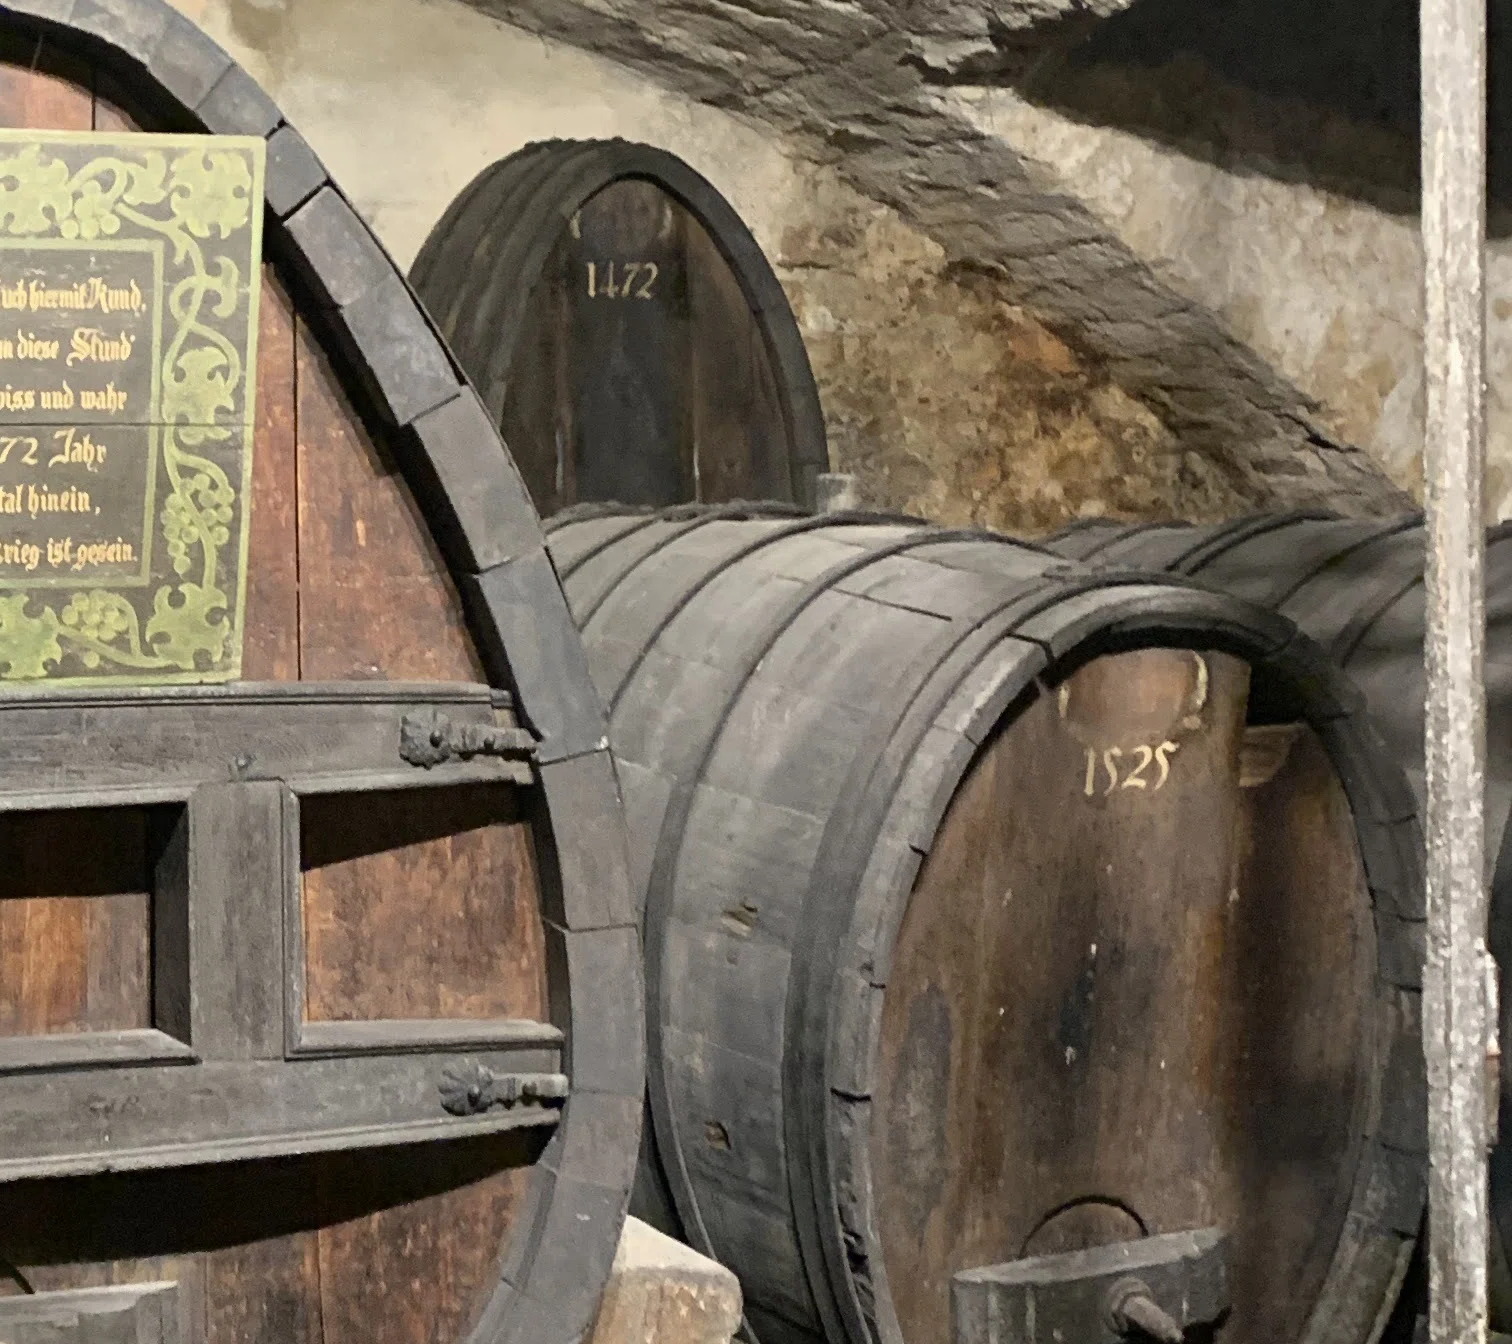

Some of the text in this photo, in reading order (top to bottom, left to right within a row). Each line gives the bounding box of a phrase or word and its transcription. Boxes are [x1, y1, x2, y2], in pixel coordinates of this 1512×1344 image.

[29, 279, 86, 312] hiermit
[584, 260, 659, 300] 1472
[17, 328, 60, 361] diese
[40, 379, 74, 410] und
[80, 381, 128, 415] wahr
[48, 427, 107, 473] Jahr
[28, 484, 101, 520] hinein,
[47, 537, 72, 568] ist
[1083, 740, 1180, 796] 1525
